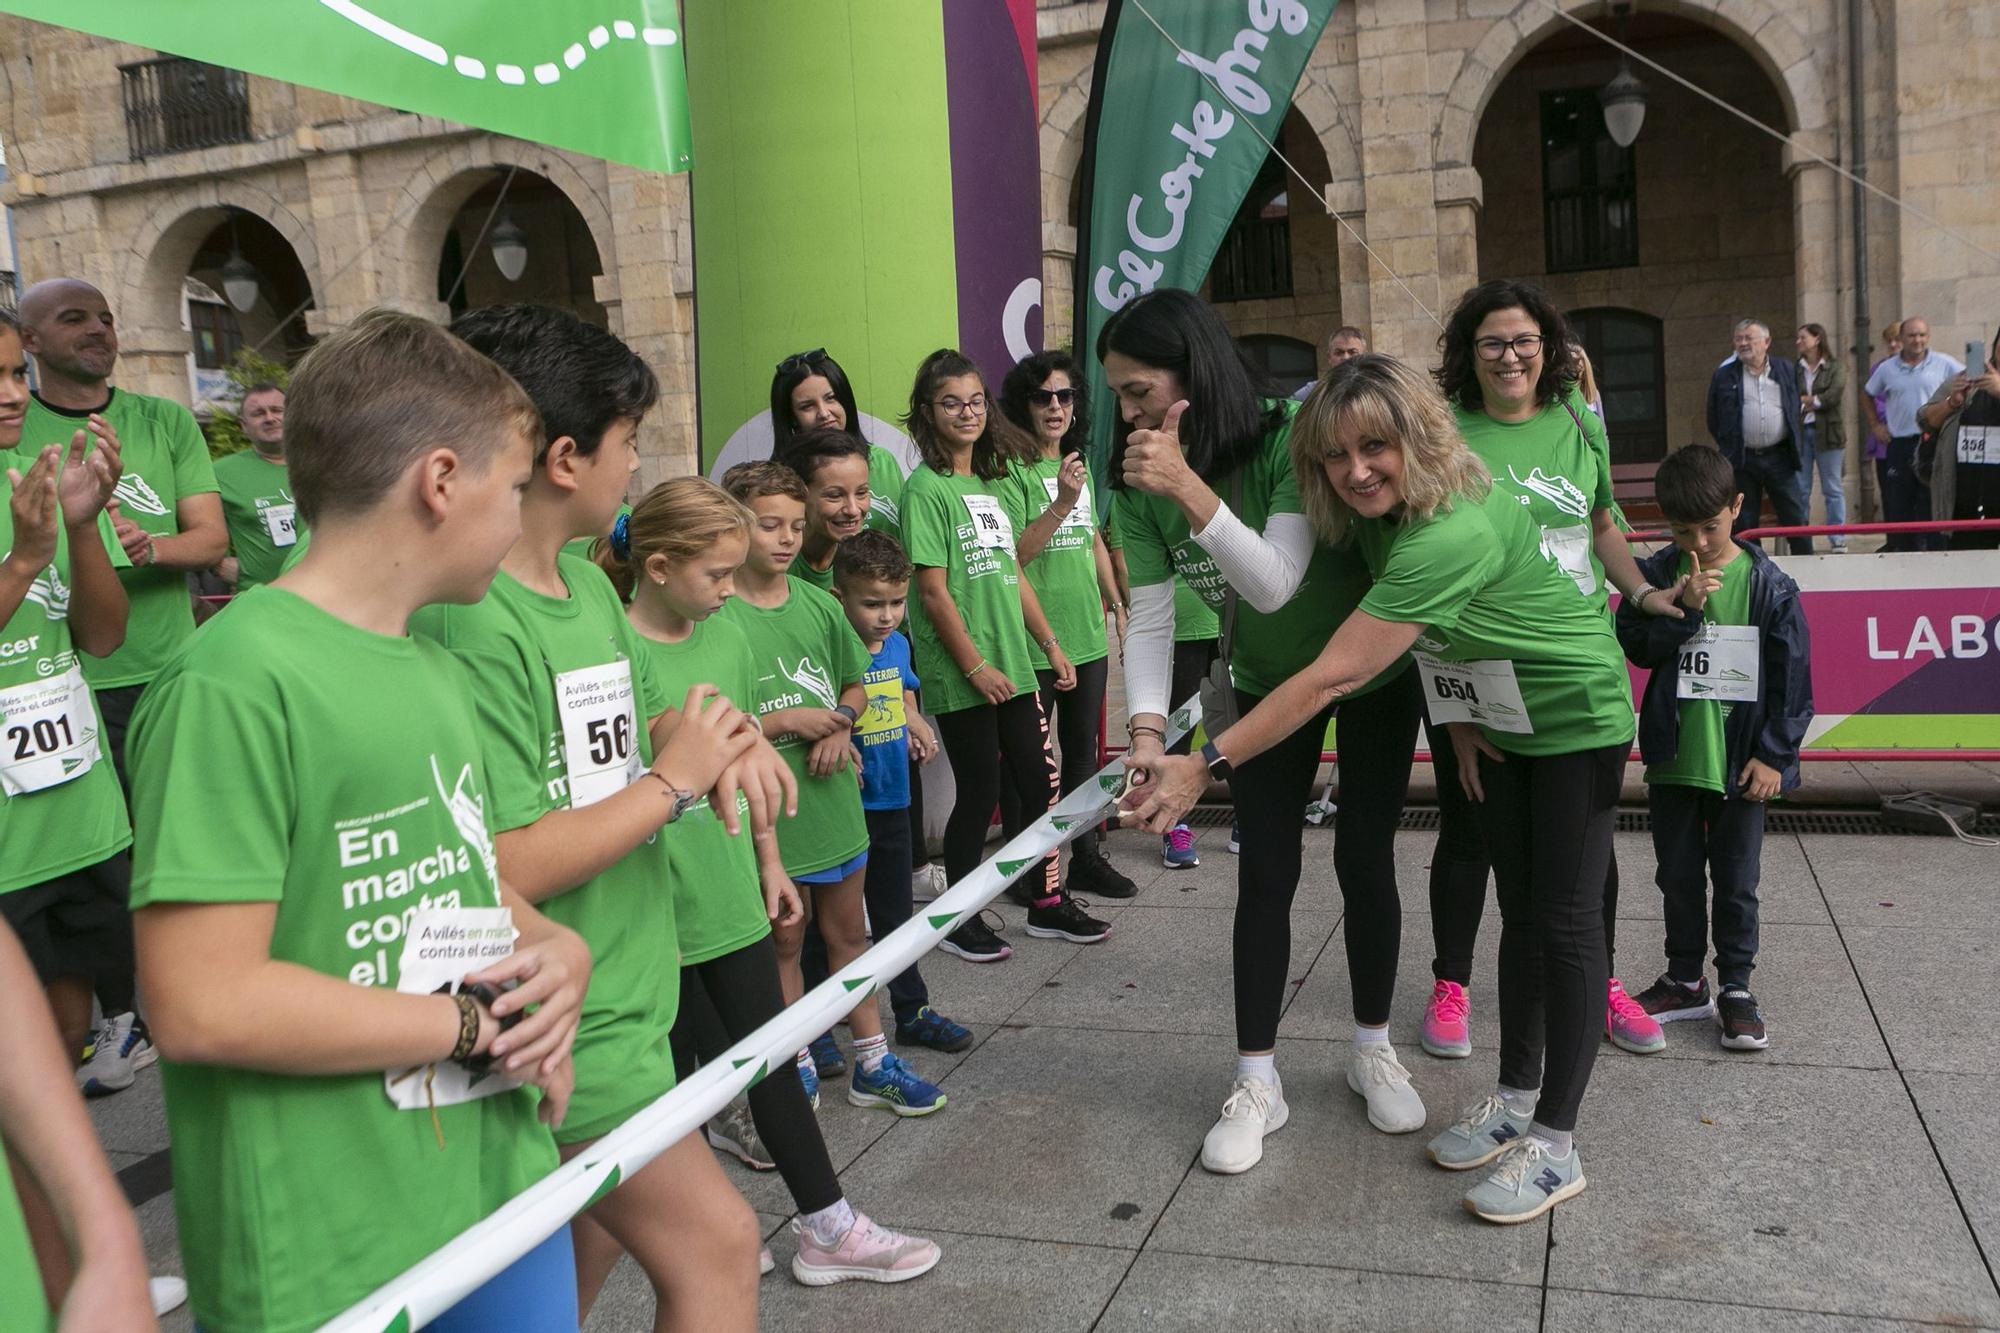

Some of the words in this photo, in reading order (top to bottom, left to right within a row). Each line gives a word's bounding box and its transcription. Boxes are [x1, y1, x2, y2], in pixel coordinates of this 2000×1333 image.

[1126, 100, 1234, 251] Corte
[977, 513, 999, 530] 796
[957, 526, 975, 540] En
[1055, 536, 1085, 547] cáncer
[1867, 614, 2000, 660] LAB
[565, 682, 600, 696] Avilés
[1434, 675, 1480, 705] 654
[568, 695, 605, 709] contra
[607, 690, 618, 702] el
[7, 713, 74, 761] 201
[338, 826, 399, 869] En
[342, 844, 471, 910] marcha
[420, 926, 466, 941] Avilés
[419, 945, 466, 960] contra
[467, 943, 479, 958] el
